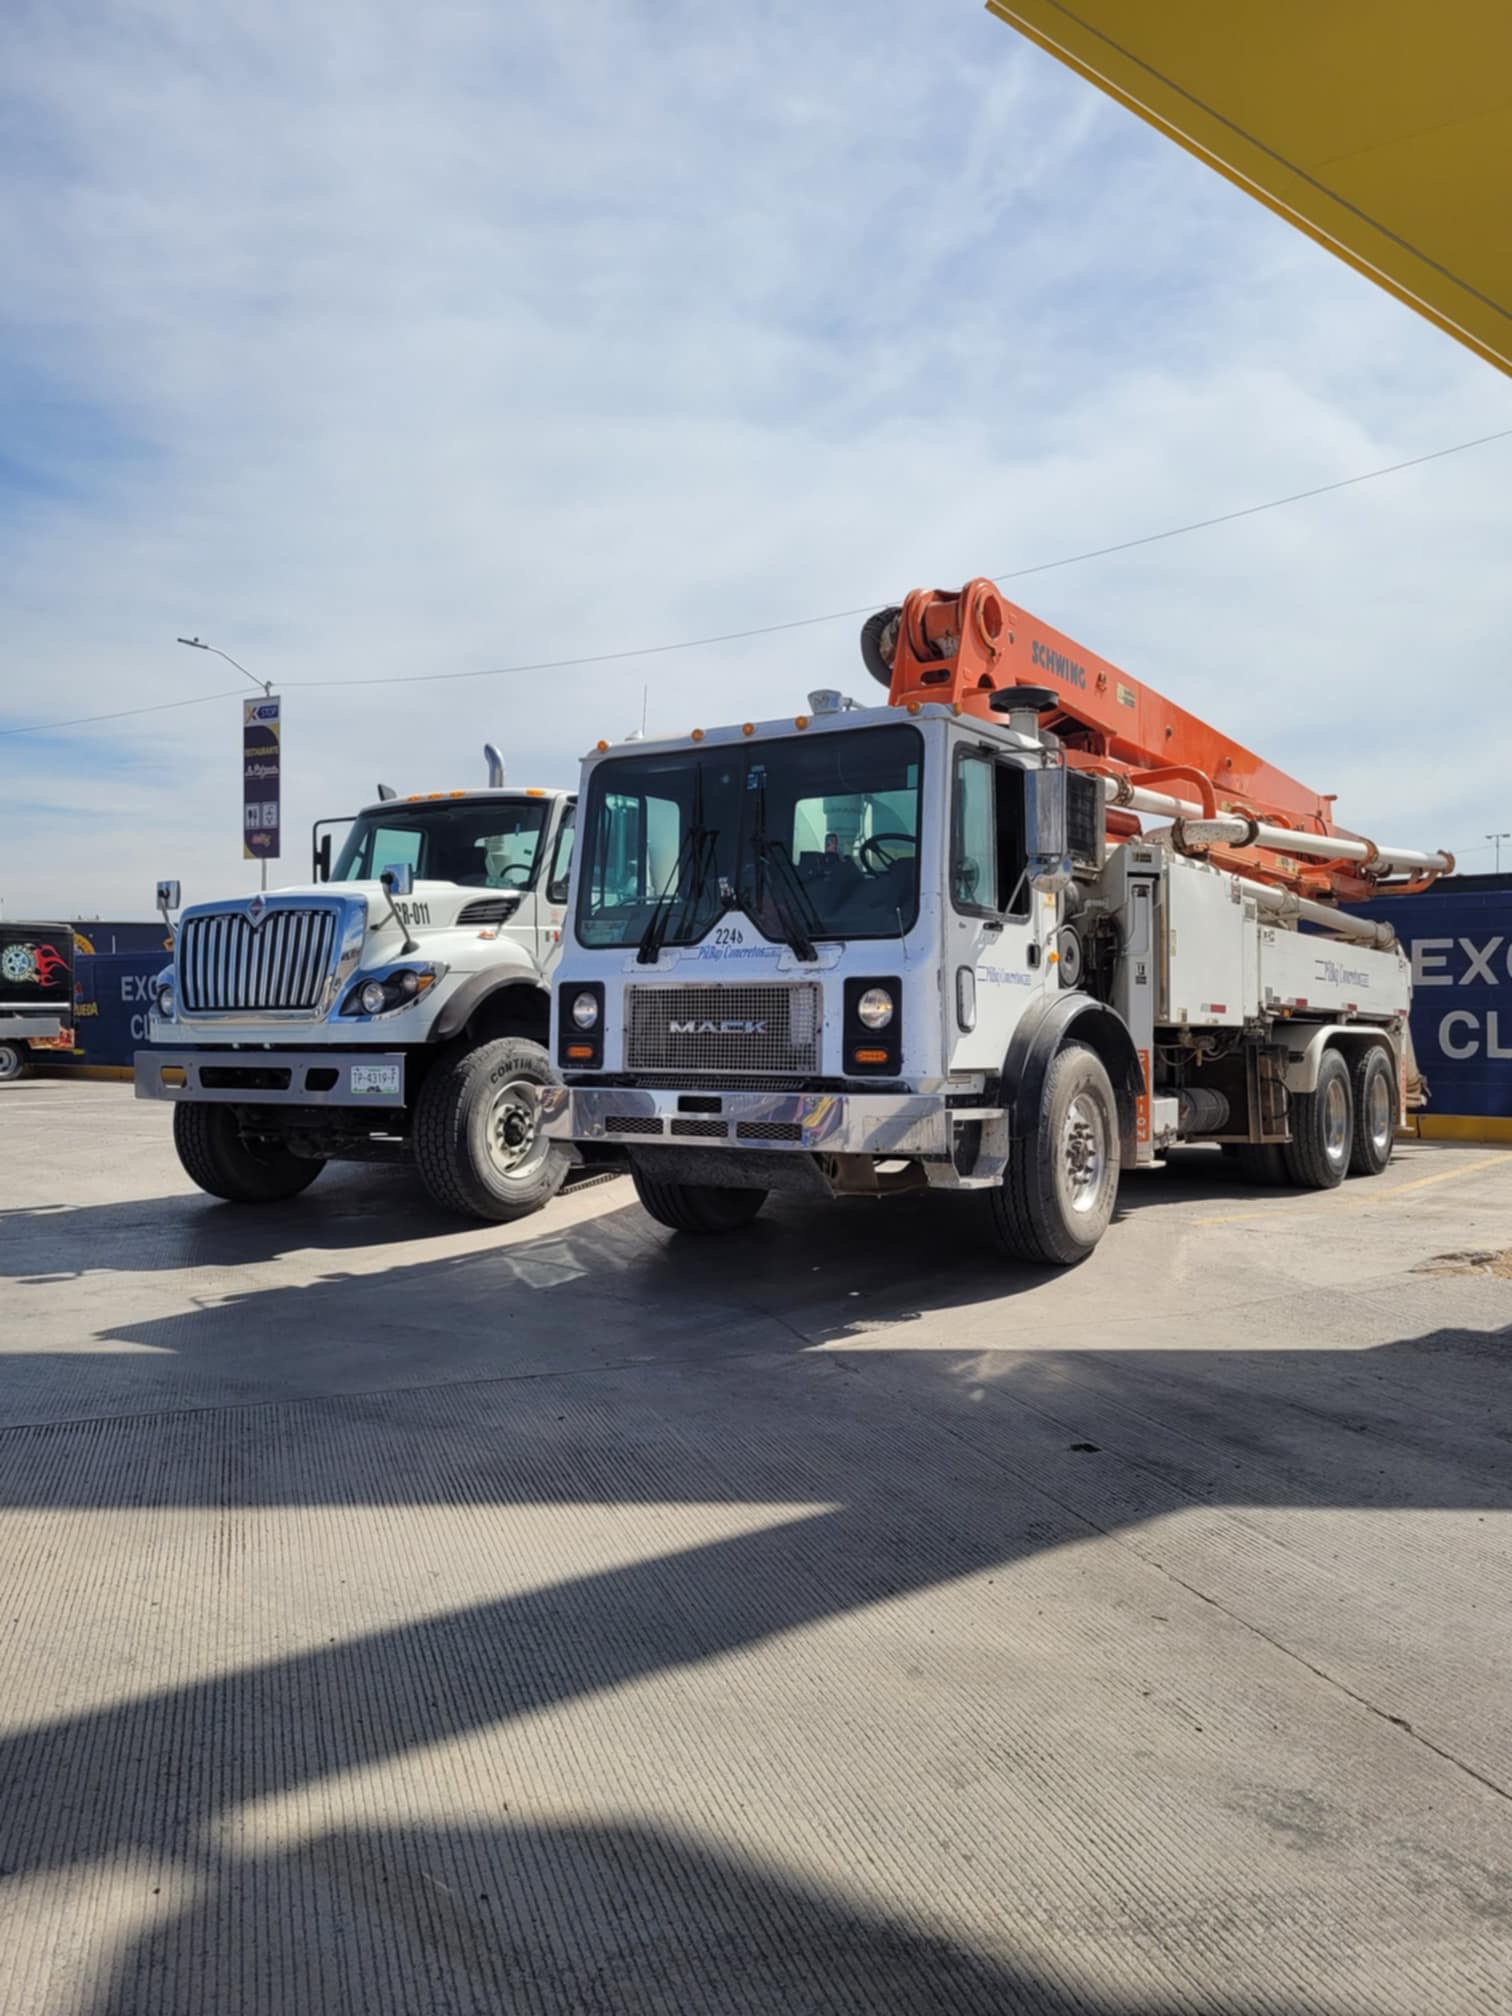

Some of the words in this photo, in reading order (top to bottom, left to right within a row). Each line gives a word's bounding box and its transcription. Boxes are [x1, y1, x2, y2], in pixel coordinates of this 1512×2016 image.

[1031, 639, 1087, 690] SCHWING
[1411, 936, 1512, 986] EX
[669, 1019, 768, 1034] MACK
